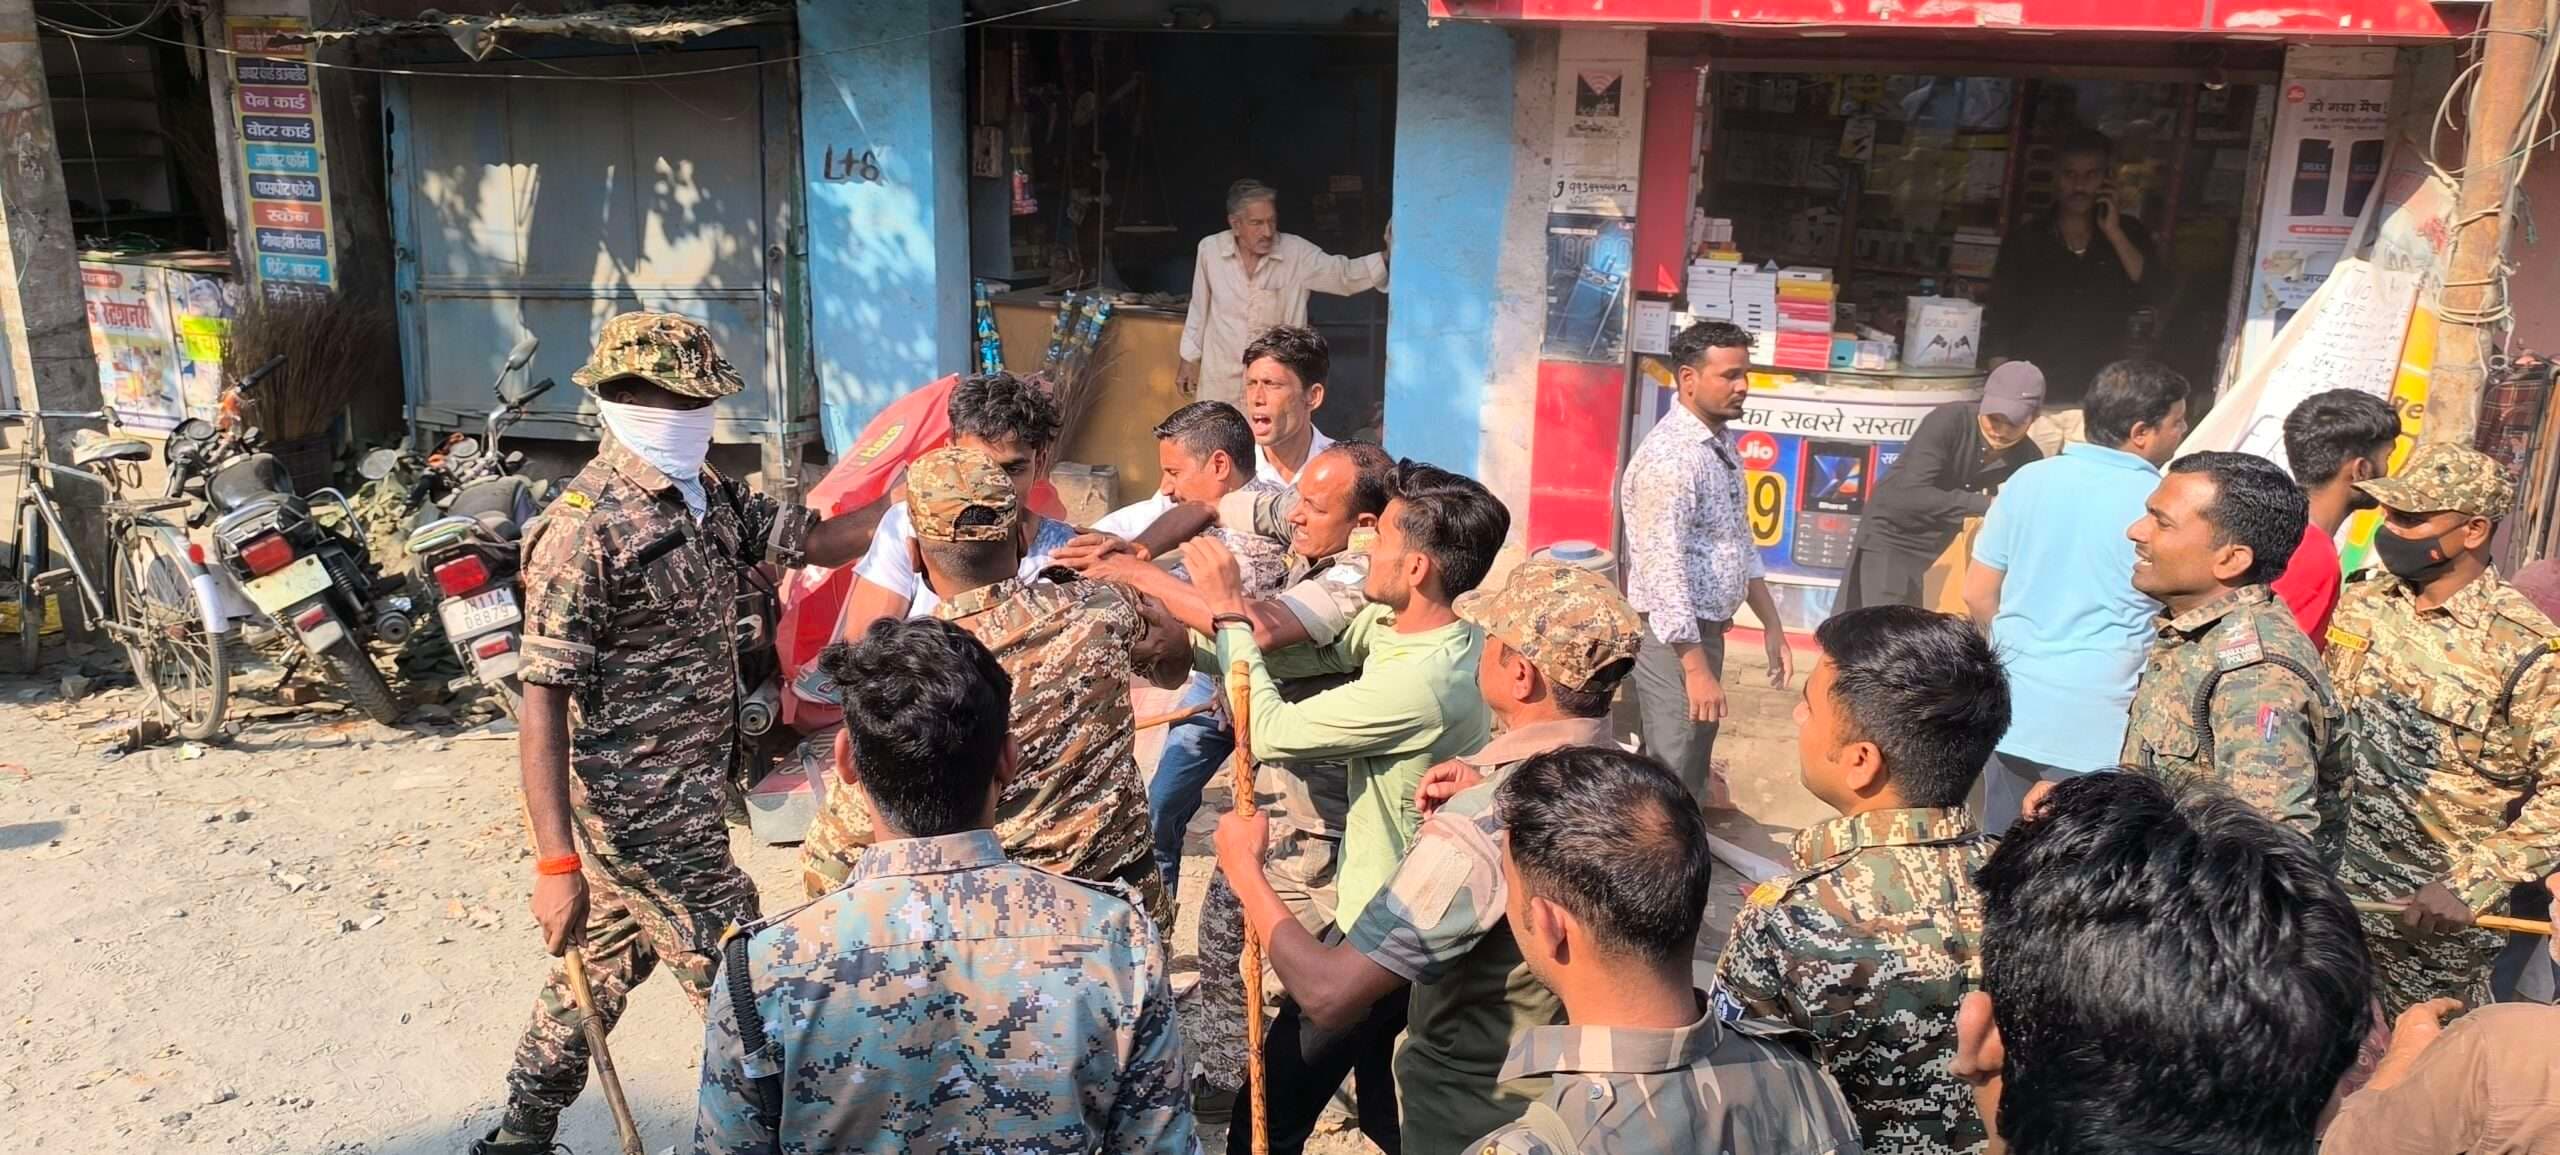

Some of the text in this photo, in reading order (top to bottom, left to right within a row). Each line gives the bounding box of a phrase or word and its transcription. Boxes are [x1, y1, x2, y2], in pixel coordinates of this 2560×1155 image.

[272, 92, 306, 109] कार्ड
[2308, 98, 2324, 113] हो
[2327, 102, 2356, 113] गया
[280, 122, 312, 139] कार्ड
[1780, 408, 1845, 433] सबसे
[1851, 414, 1917, 436] सस्ता
[1740, 440, 1774, 460] Jio
